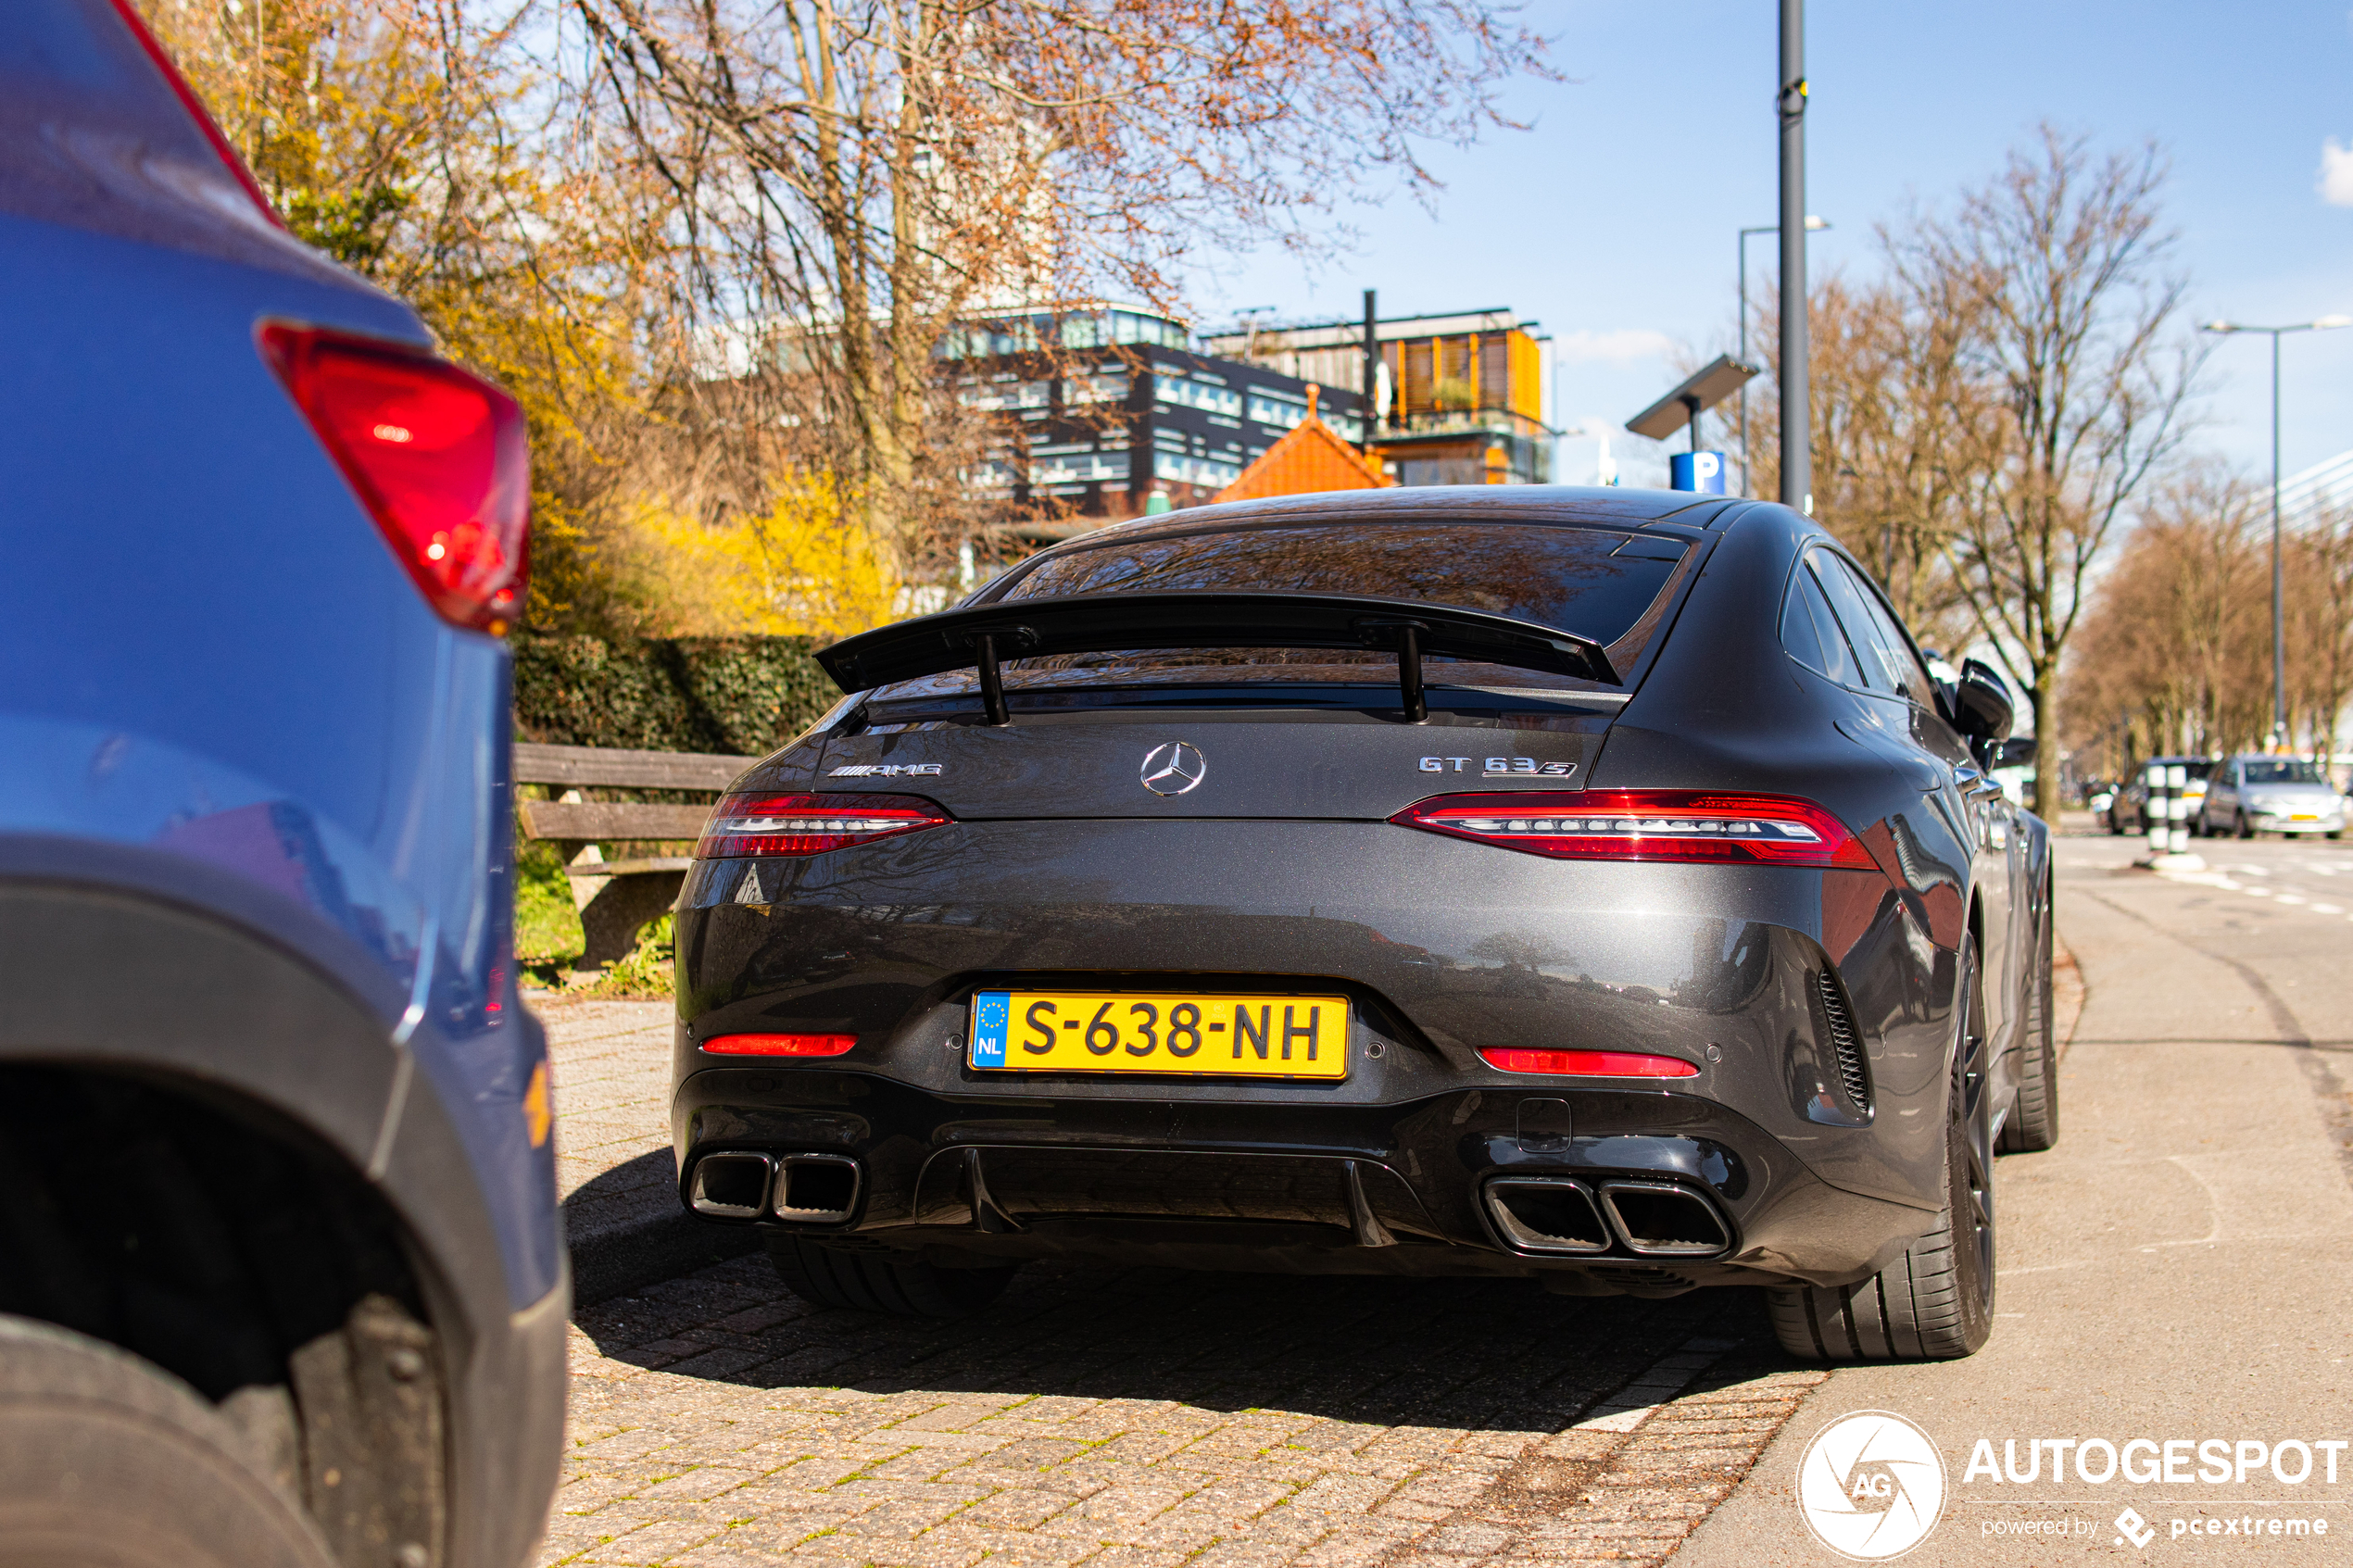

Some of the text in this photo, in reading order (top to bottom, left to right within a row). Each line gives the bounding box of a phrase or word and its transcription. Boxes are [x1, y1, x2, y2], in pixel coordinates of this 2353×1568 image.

[1692, 451, 1719, 493] P
[869, 764, 943, 777] AMG
[1417, 757, 1472, 773] GT
[1023, 999, 1321, 1061] S-638-NH
[977, 1037, 1002, 1055] NL
